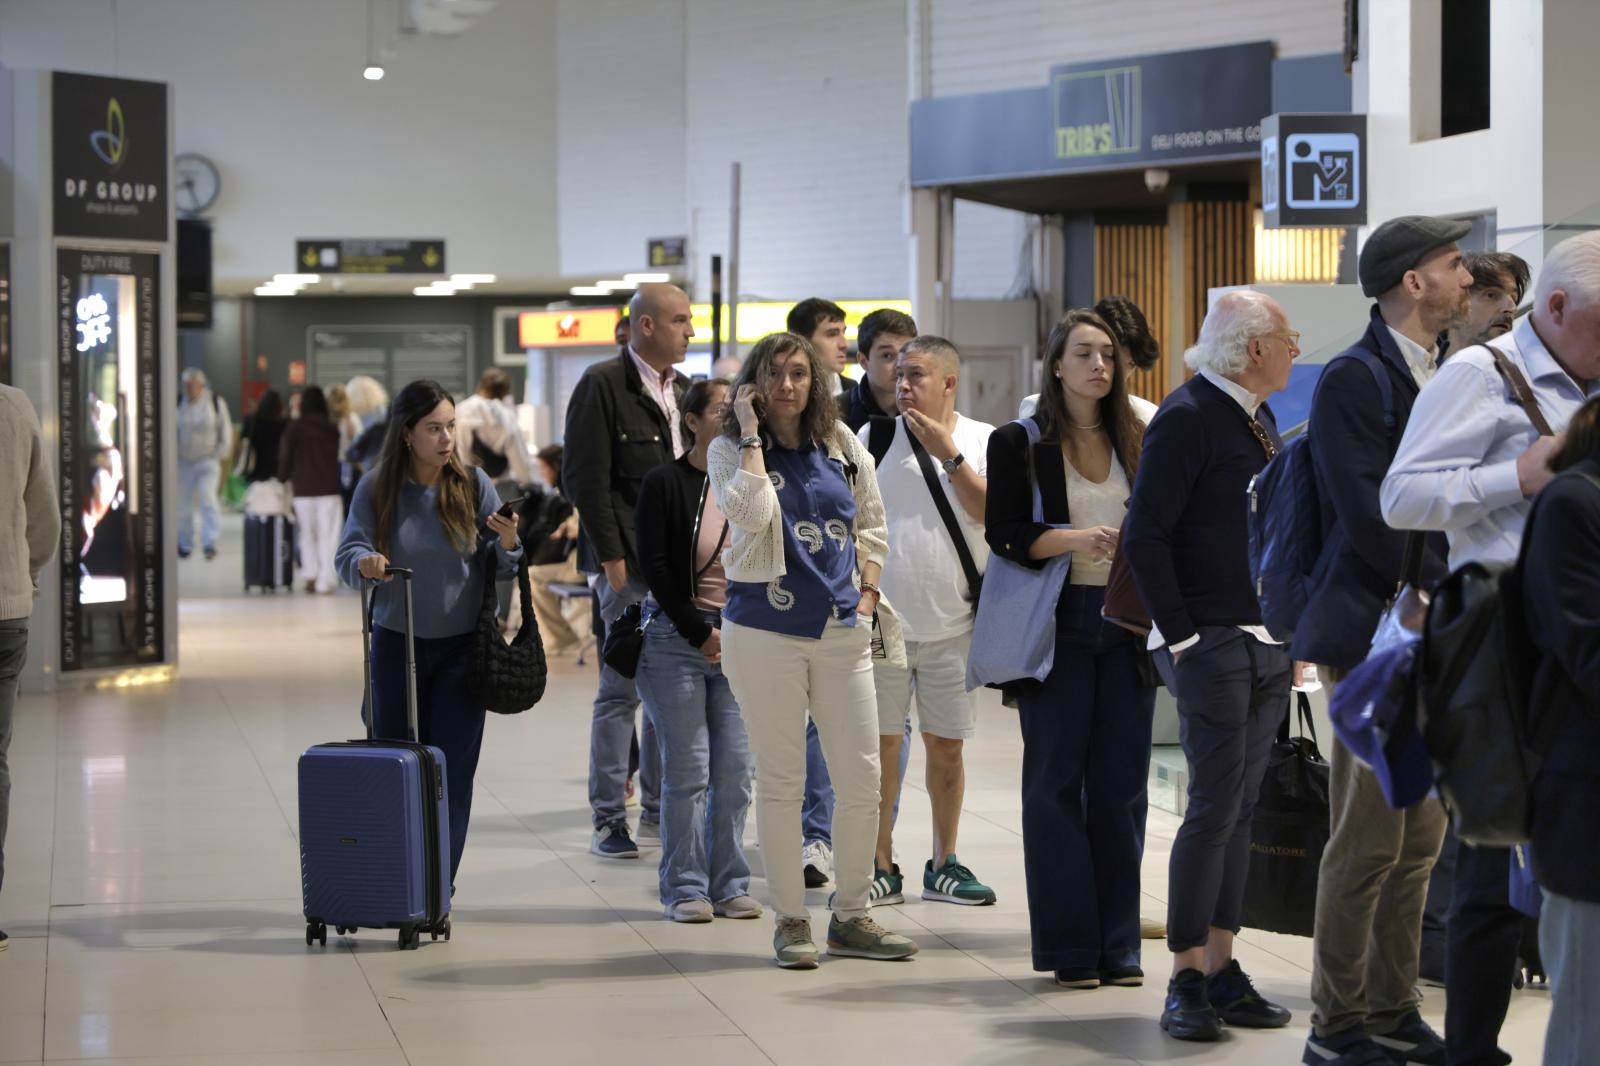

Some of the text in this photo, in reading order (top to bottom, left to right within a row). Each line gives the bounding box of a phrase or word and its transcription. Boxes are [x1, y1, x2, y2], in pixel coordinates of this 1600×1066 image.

[1056, 123, 1112, 159] TRIB'S
[1174, 131, 1204, 149] FOOD
[1205, 130, 1223, 146] ON
[1223, 127, 1243, 144] THE
[65, 178, 157, 202] DF GROUP
[81, 254, 131, 273] DUTY FREE
[61, 275, 70, 303] FLY
[61, 320, 71, 364] SHOP
[143, 373, 153, 415] SHOP
[143, 431, 153, 458] FLY
[63, 476, 72, 503] FLY
[63, 519, 73, 564] SHOP
[144, 568, 154, 610] SHOP
